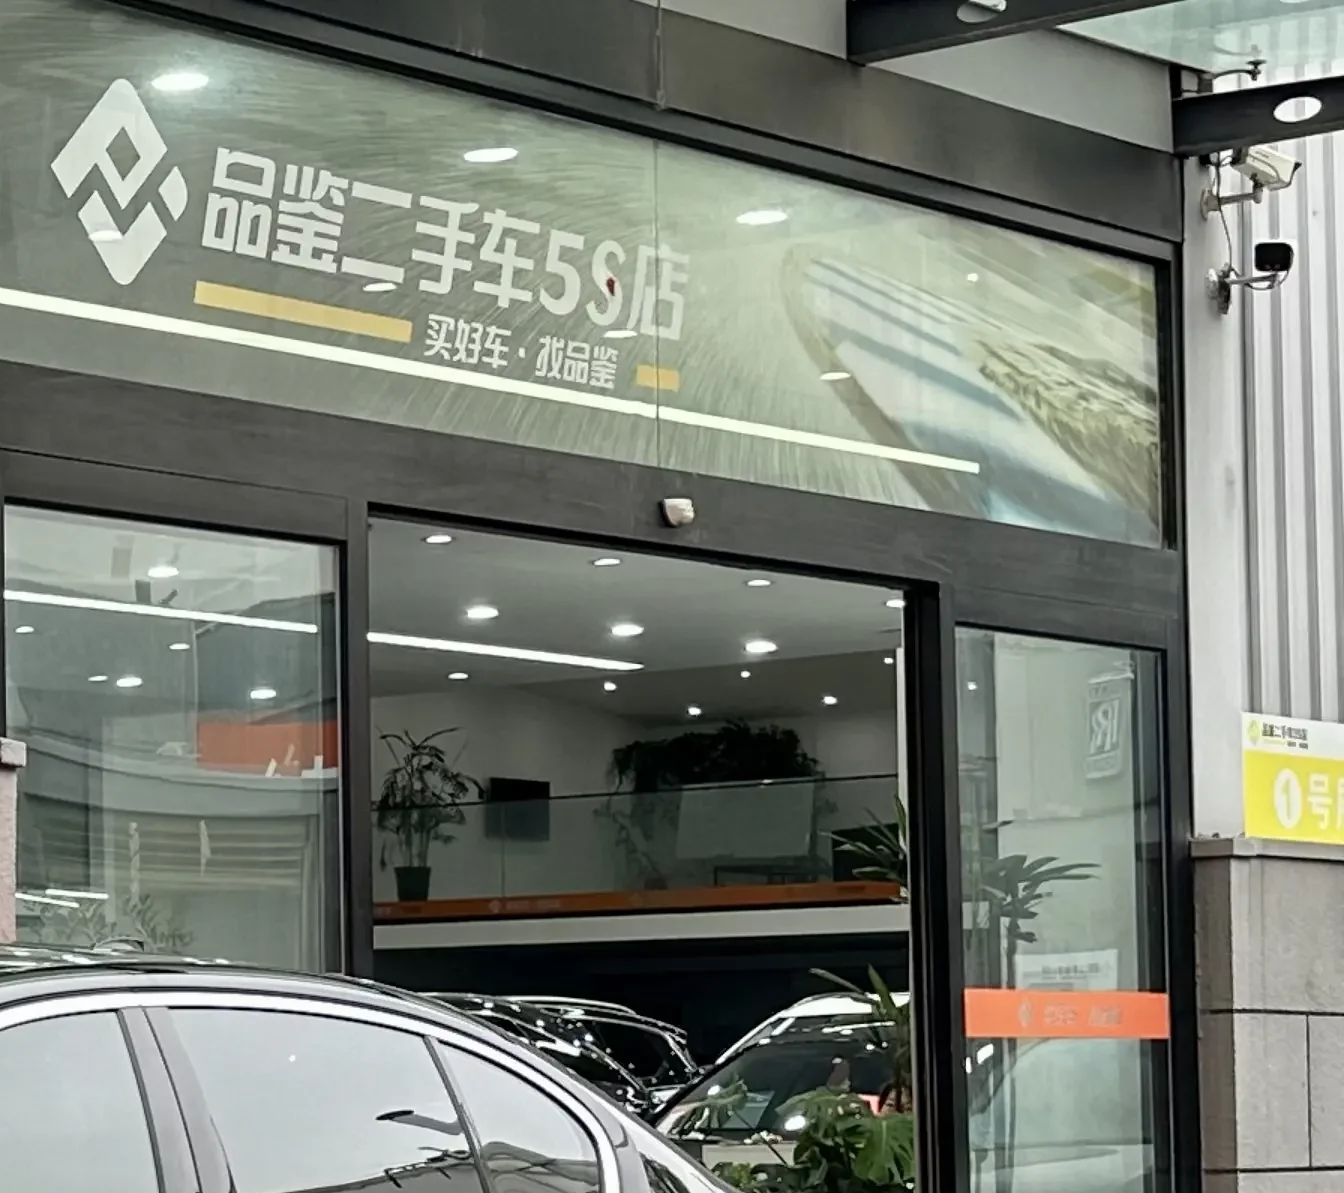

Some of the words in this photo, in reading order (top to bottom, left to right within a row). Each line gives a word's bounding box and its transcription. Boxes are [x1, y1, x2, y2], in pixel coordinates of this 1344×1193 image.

[201, 146, 691, 341] 品鉴二手车5S店
